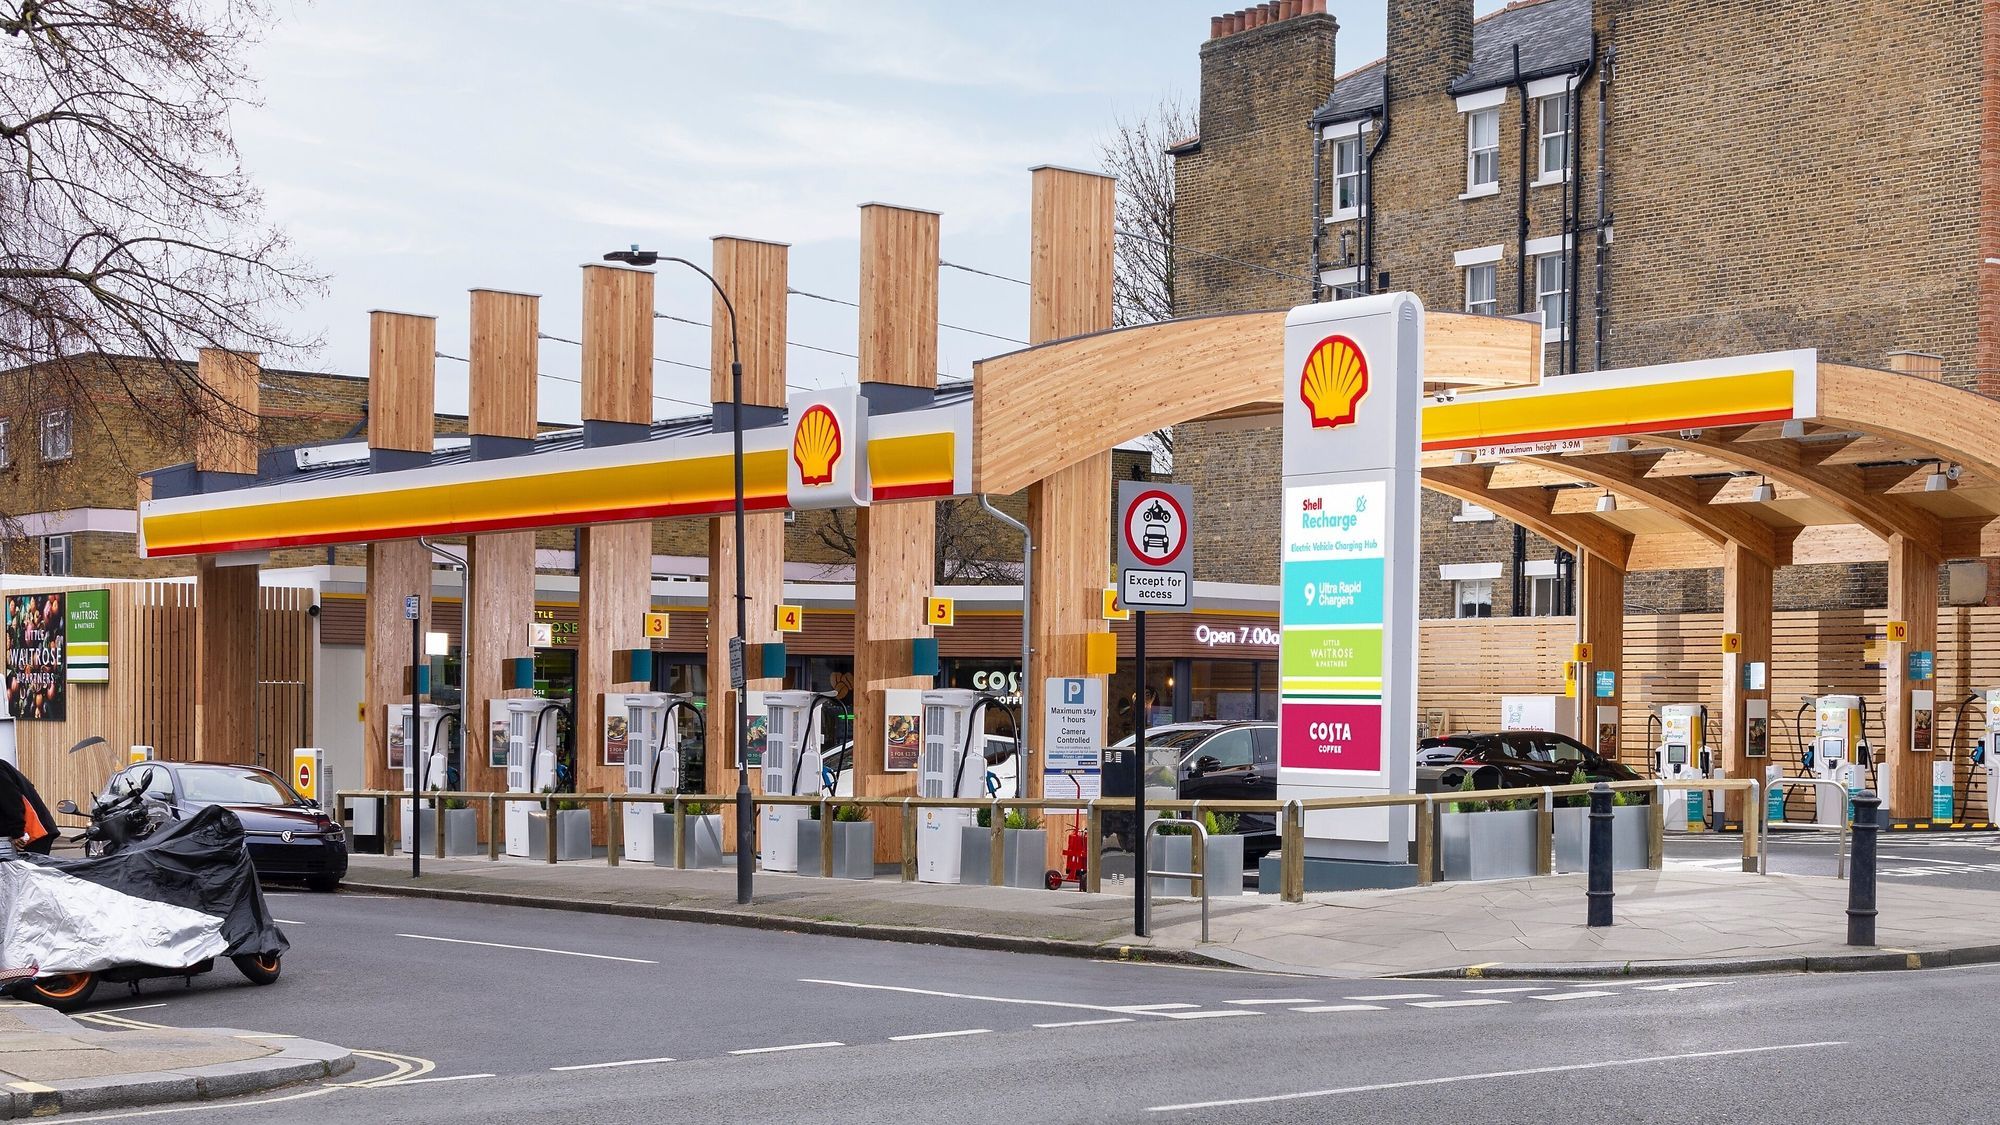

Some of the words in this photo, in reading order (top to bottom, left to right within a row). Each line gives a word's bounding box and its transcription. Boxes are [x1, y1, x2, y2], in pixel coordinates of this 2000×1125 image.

[1499, 445, 1533, 455] Maximum
[1535, 442, 1558, 453] height
[1562, 441, 1581, 449] 3.9M
[1302, 497, 1323, 511] Shell
[1302, 510, 1357, 531] Recharge
[1291, 542, 1311, 552] Electric
[1312, 541, 1334, 551] Vehicle
[1335, 540, 1363, 551] Charging
[1364, 539, 1378, 549] Hub
[1129, 574, 1165, 588] Except
[1167, 576, 1182, 587] for
[1138, 590, 1173, 599] access
[1304, 582, 1316, 606] 9
[1319, 583, 1338, 594] Ultra
[1339, 581, 1362, 595] Rapid
[1318, 594, 1355, 608] Chargers
[71, 611, 99, 620] WAITROSE
[937, 604, 946, 619] 5
[785, 612, 796, 625] 4
[653, 619, 663, 632] 3
[1895, 626, 1905, 637] 10
[25, 630, 46, 641] LITTLE
[537, 629, 546, 642] 2
[1196, 624, 1236, 647] Open
[1323, 639, 1340, 647] LITTLE
[1731, 638, 1738, 649] 9
[10, 648, 62, 666] WAITROSE
[1310, 648, 1354, 659] WAITROSE
[1582, 648, 1588, 658] 8
[1320, 660, 1348, 668] PARTNERS
[1050, 707, 1082, 715] Maximum
[1083, 707, 1097, 717] stay
[1067, 716, 1086, 724] hours
[1061, 728, 1086, 736] Camera
[1309, 722, 1352, 743] COSTA
[1056, 736, 1091, 744] Controlled
[1318, 745, 1342, 754] COFFEE
